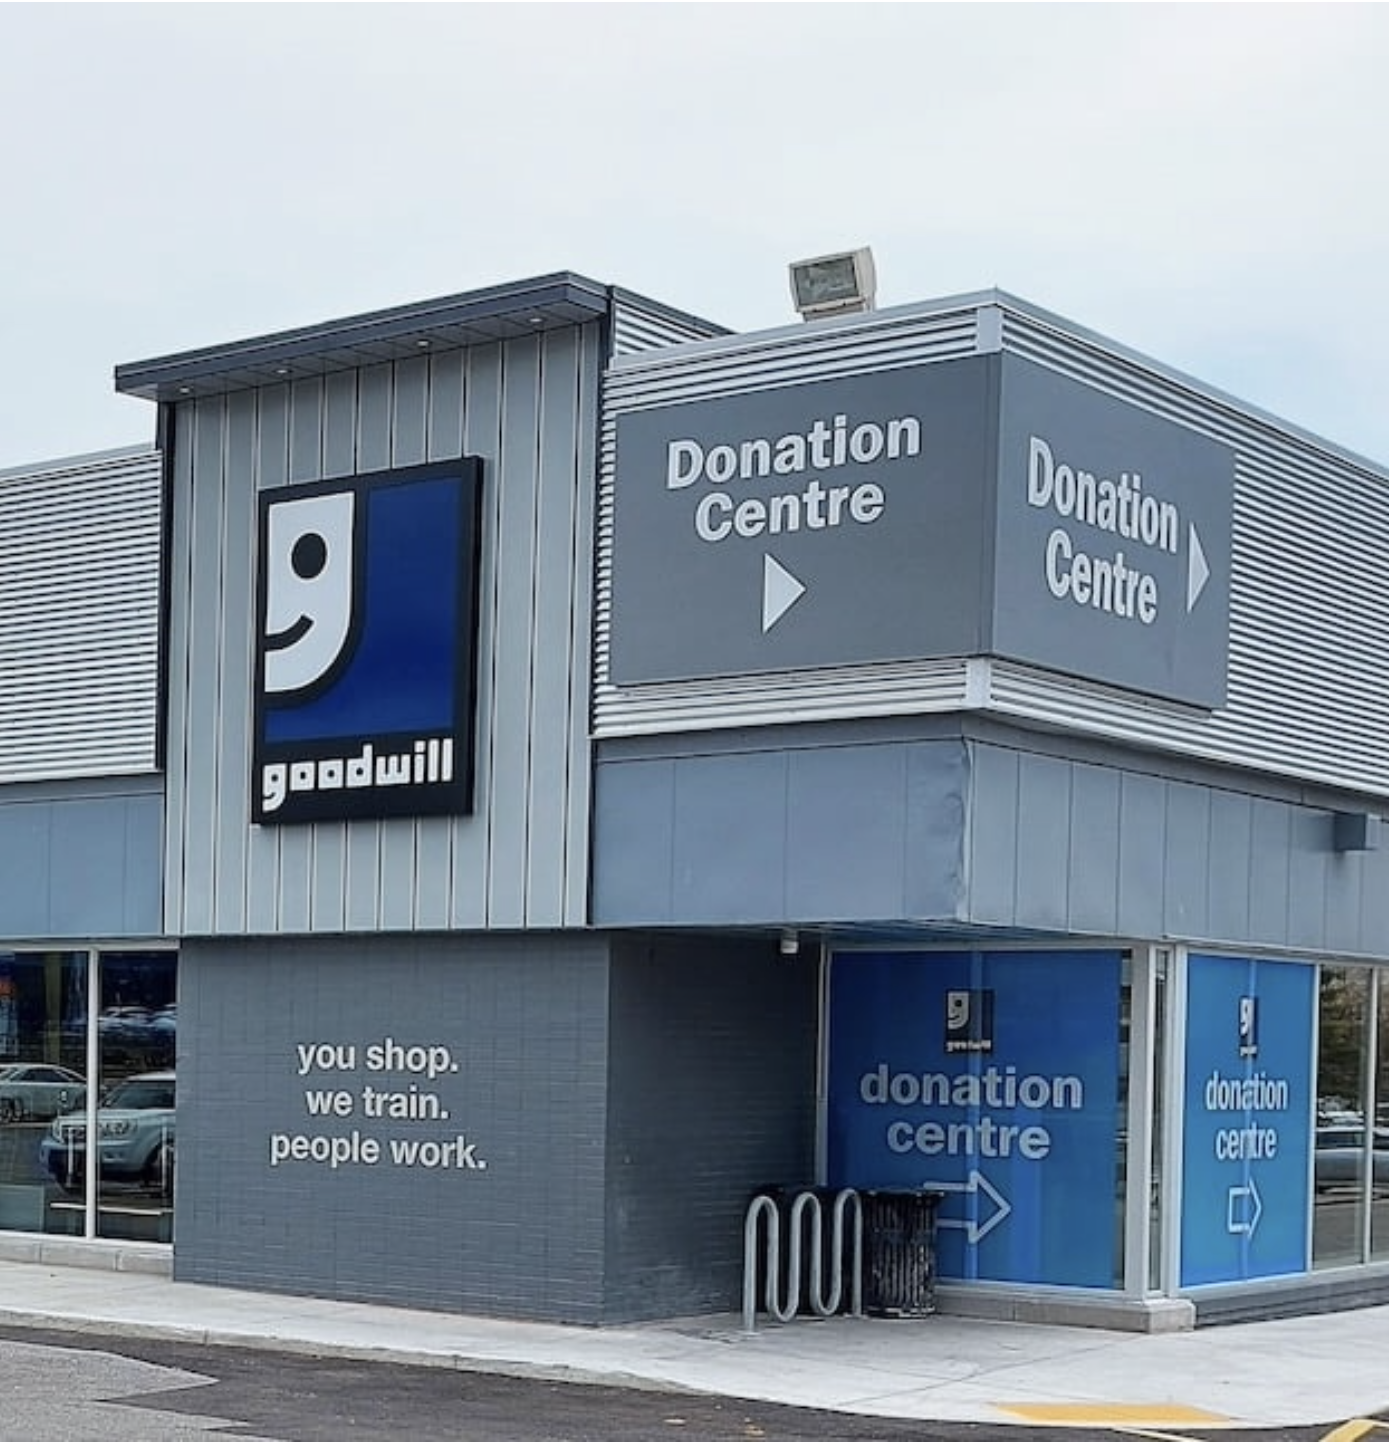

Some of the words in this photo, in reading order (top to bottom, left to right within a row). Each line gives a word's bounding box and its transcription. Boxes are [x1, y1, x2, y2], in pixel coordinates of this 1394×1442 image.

[666, 413, 922, 490] Donation
[694, 480, 886, 543] Centre
[1028, 435, 1180, 554] Donation
[1045, 528, 1159, 625] Centre
[262, 738, 453, 813] goodwill
[297, 1044, 355, 1075] you
[366, 1037, 459, 1079] shop.
[306, 1090, 353, 1116] we
[363, 1085, 449, 1119] train.
[860, 1063, 1083, 1109] donation
[1206, 1069, 1288, 1110] donation
[270, 1131, 380, 1169] people
[389, 1135, 488, 1169] work.
[887, 1117, 1050, 1160] centre
[1215, 1121, 1277, 1160] centre
